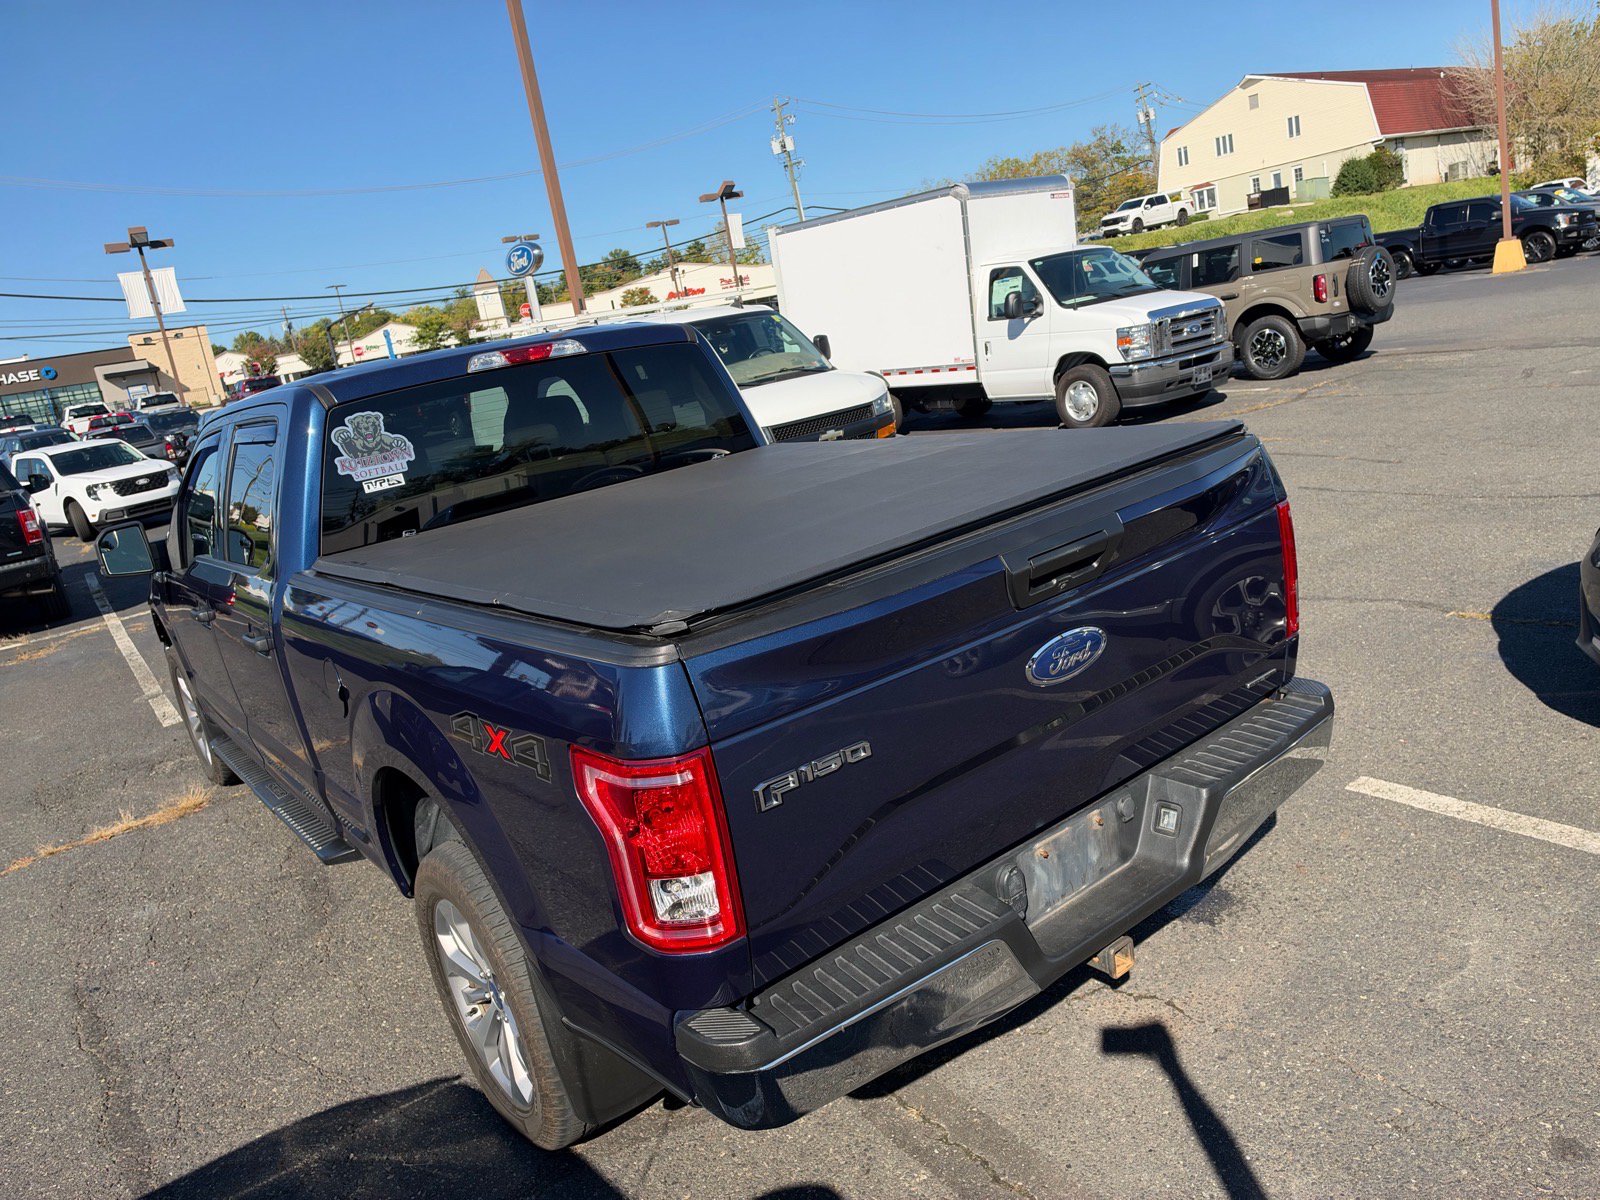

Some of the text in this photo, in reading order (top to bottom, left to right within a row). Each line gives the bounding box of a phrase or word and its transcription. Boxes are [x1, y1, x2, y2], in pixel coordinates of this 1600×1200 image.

[511, 250, 529, 271] Ford
[354, 462, 407, 480] SOFTBALL
[1049, 640, 1092, 675] Ford
